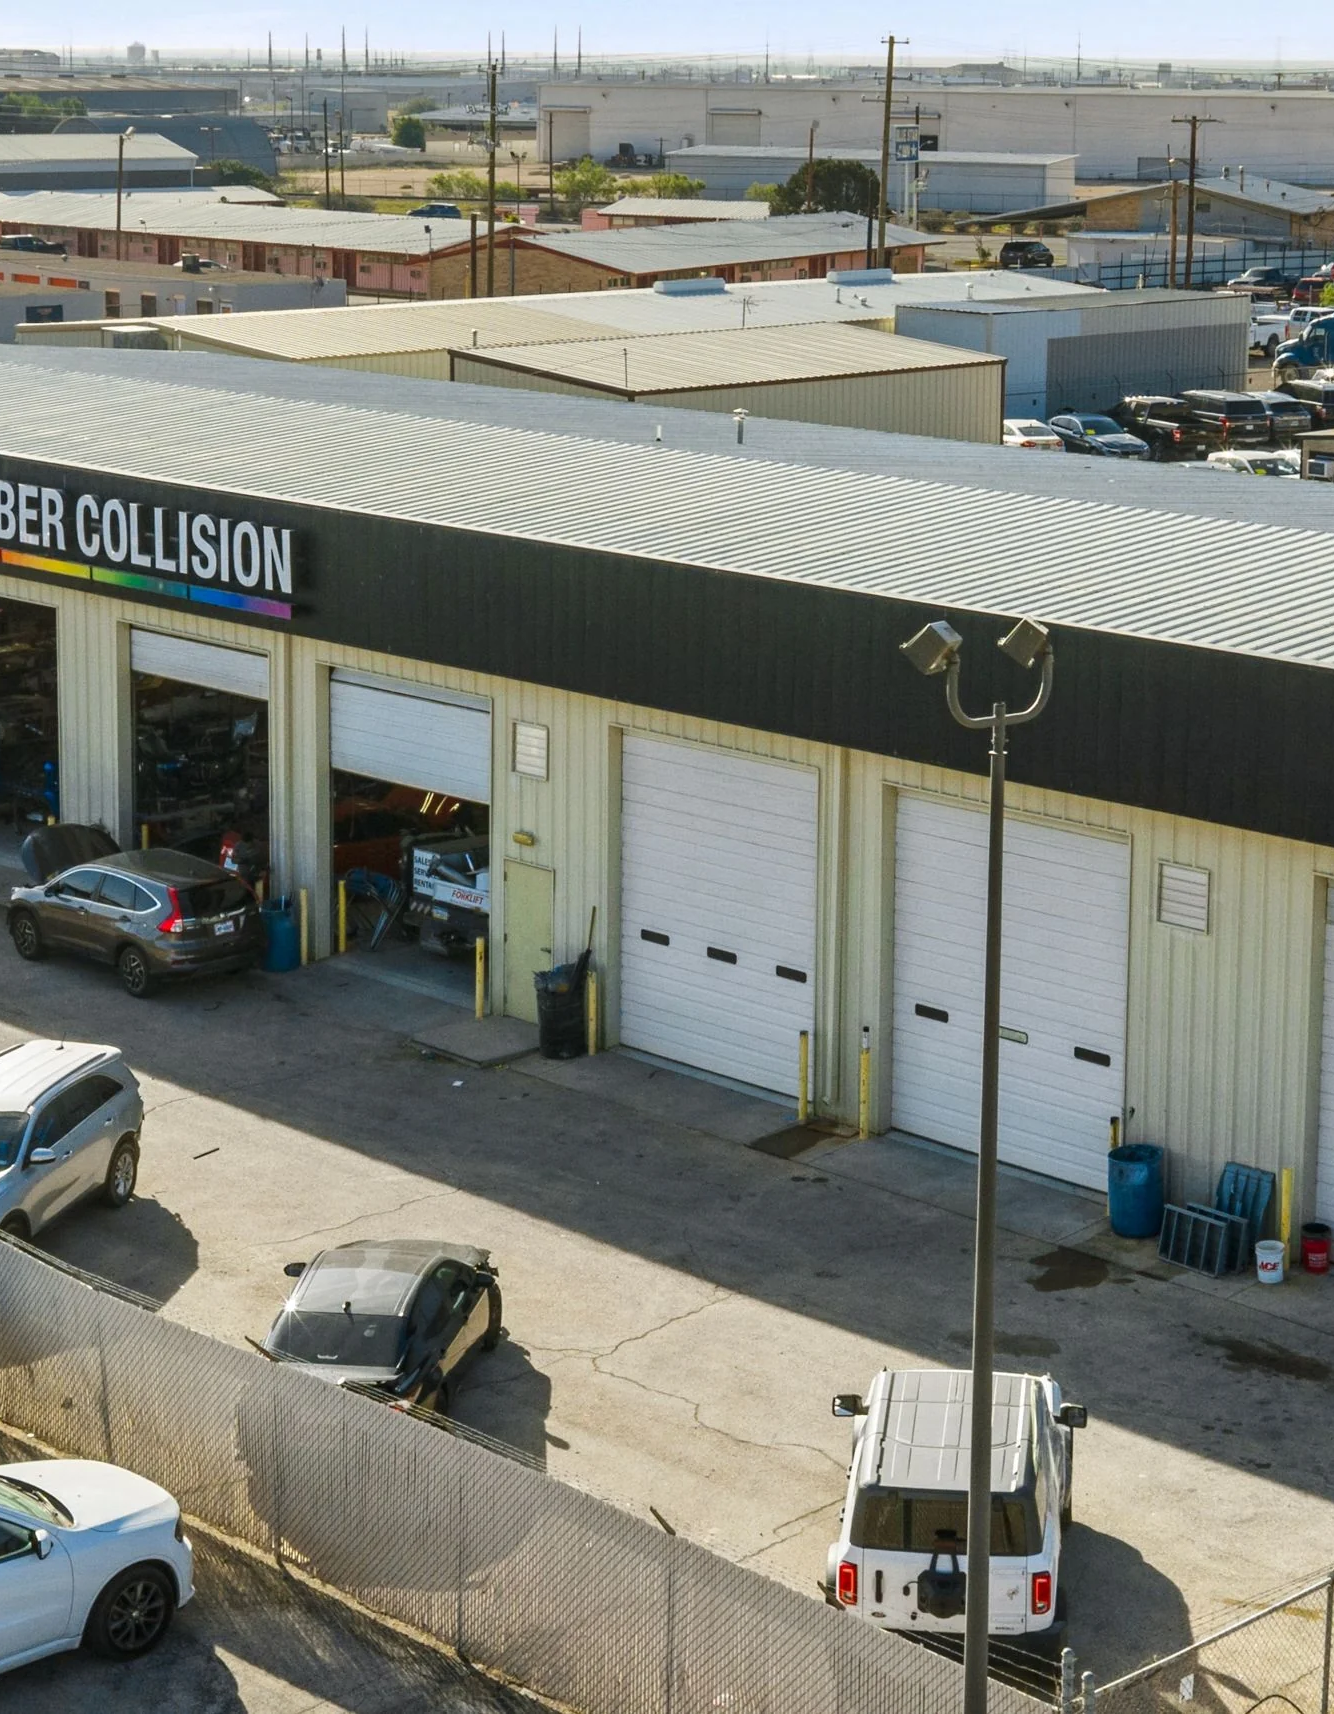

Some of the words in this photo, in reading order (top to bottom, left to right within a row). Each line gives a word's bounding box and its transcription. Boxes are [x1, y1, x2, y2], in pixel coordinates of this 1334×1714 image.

[76, 494, 292, 594] COLLISION
[452, 890, 483, 905] FORKLIFT
[1259, 1261, 1280, 1272] ACE
